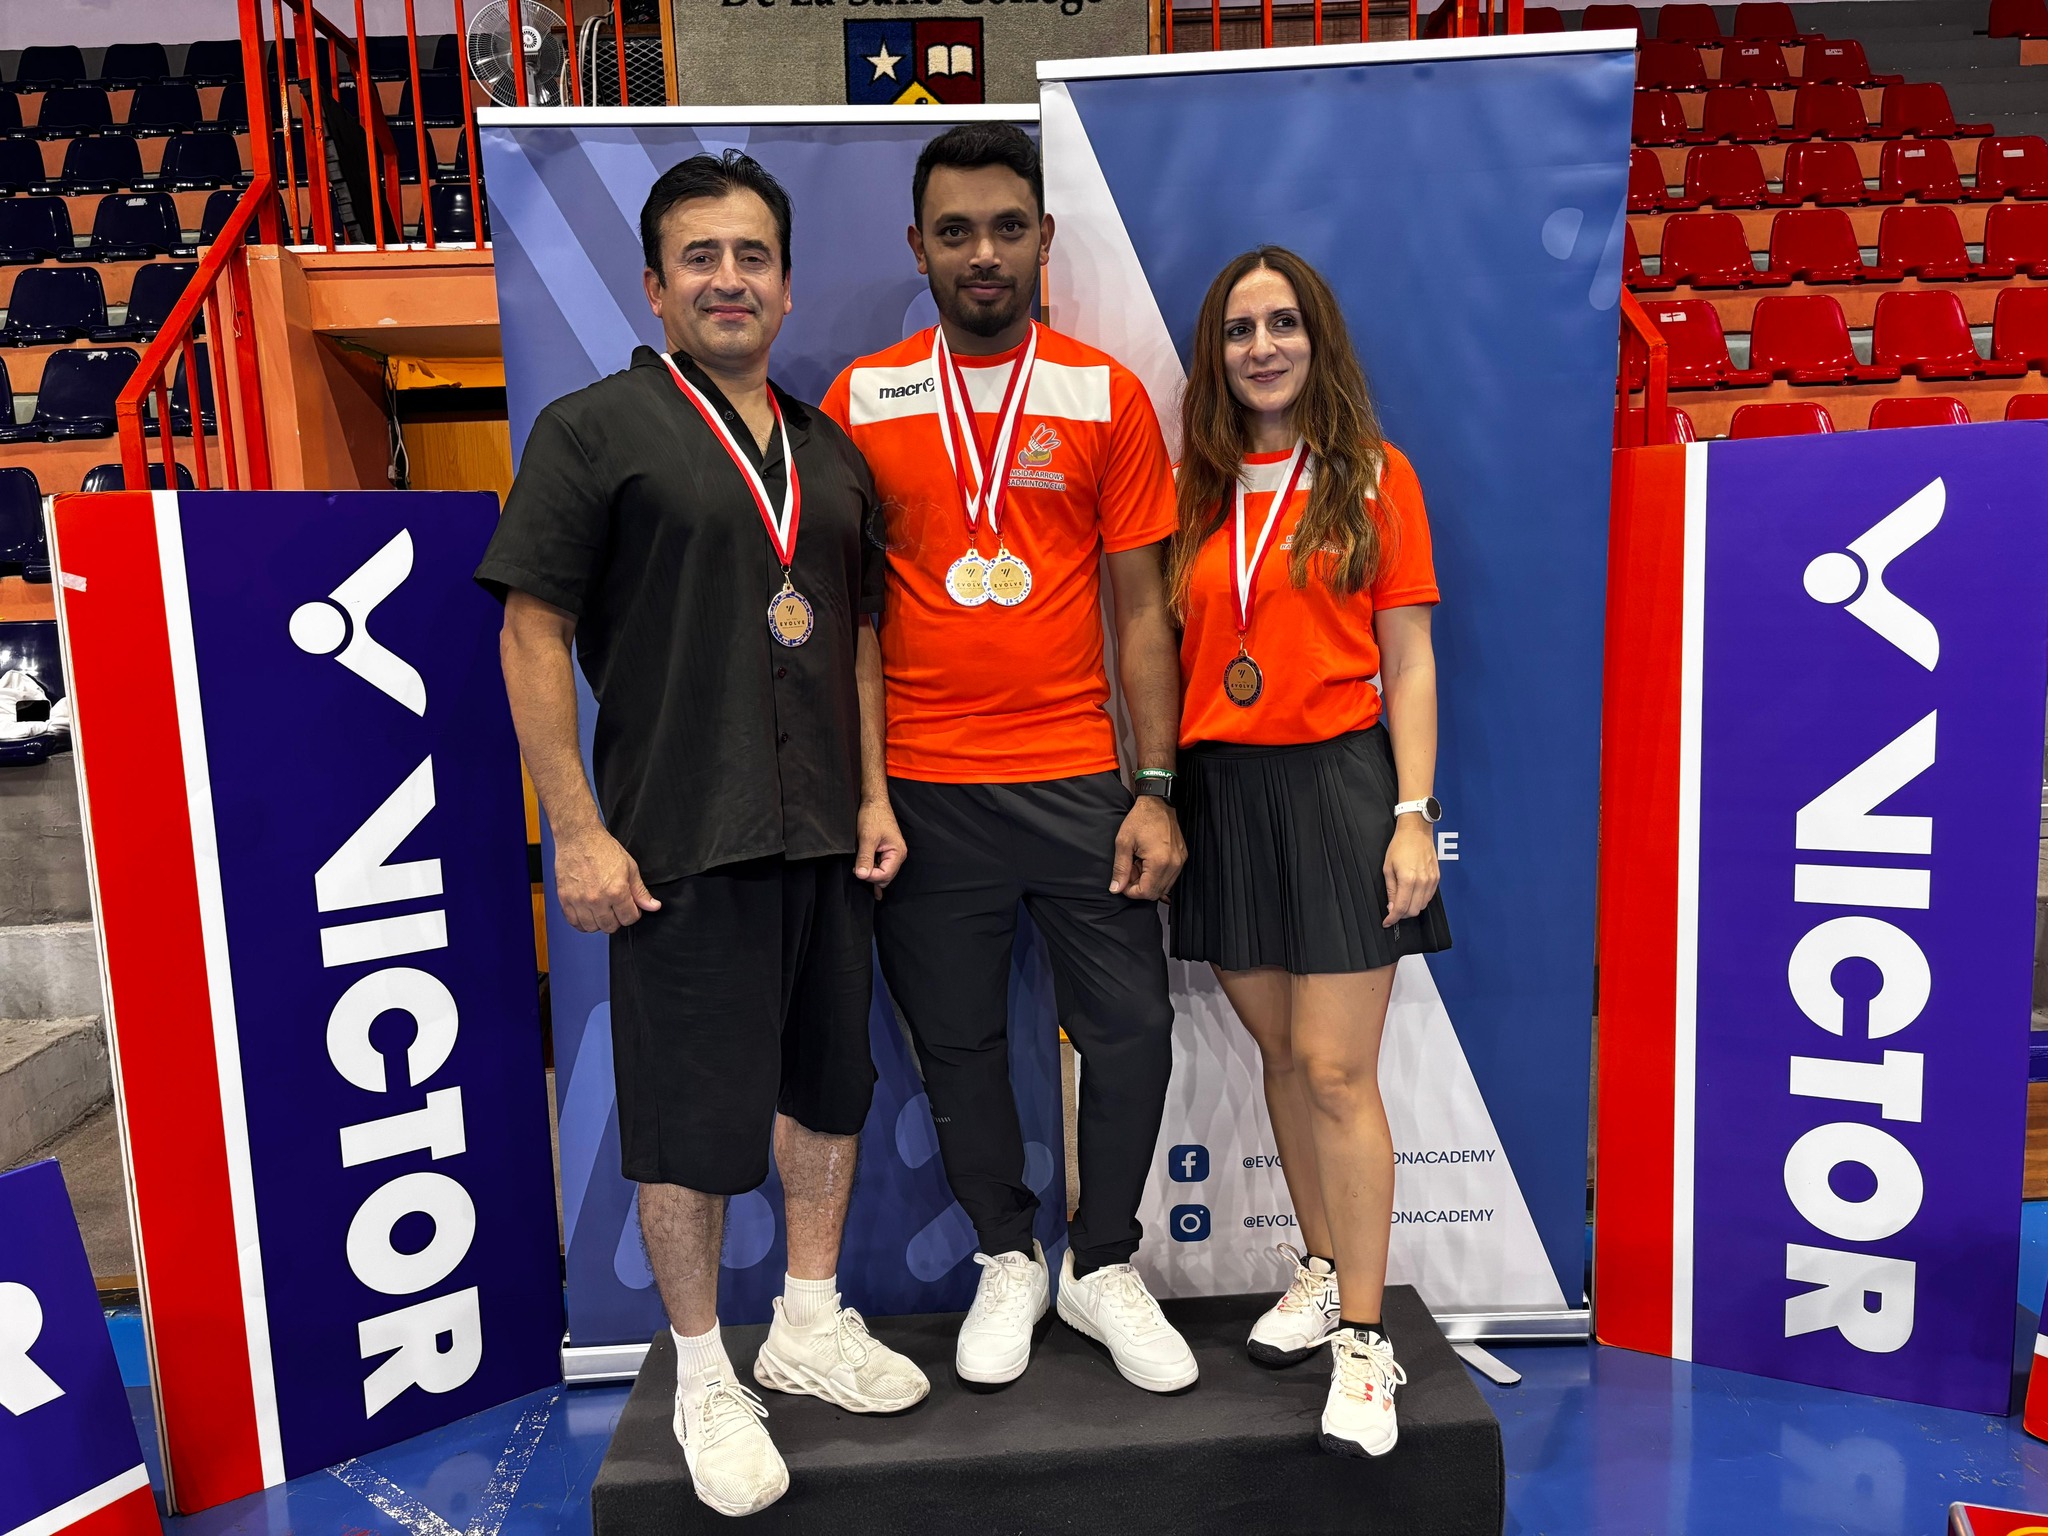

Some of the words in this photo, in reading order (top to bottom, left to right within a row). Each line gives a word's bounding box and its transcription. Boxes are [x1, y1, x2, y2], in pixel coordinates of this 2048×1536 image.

[879, 377, 935, 399] macro
[1035, 471, 1064, 480] ARROWS
[315, 754, 483, 1419] VICTOR
[1784, 710, 1937, 1353] VICTOR
